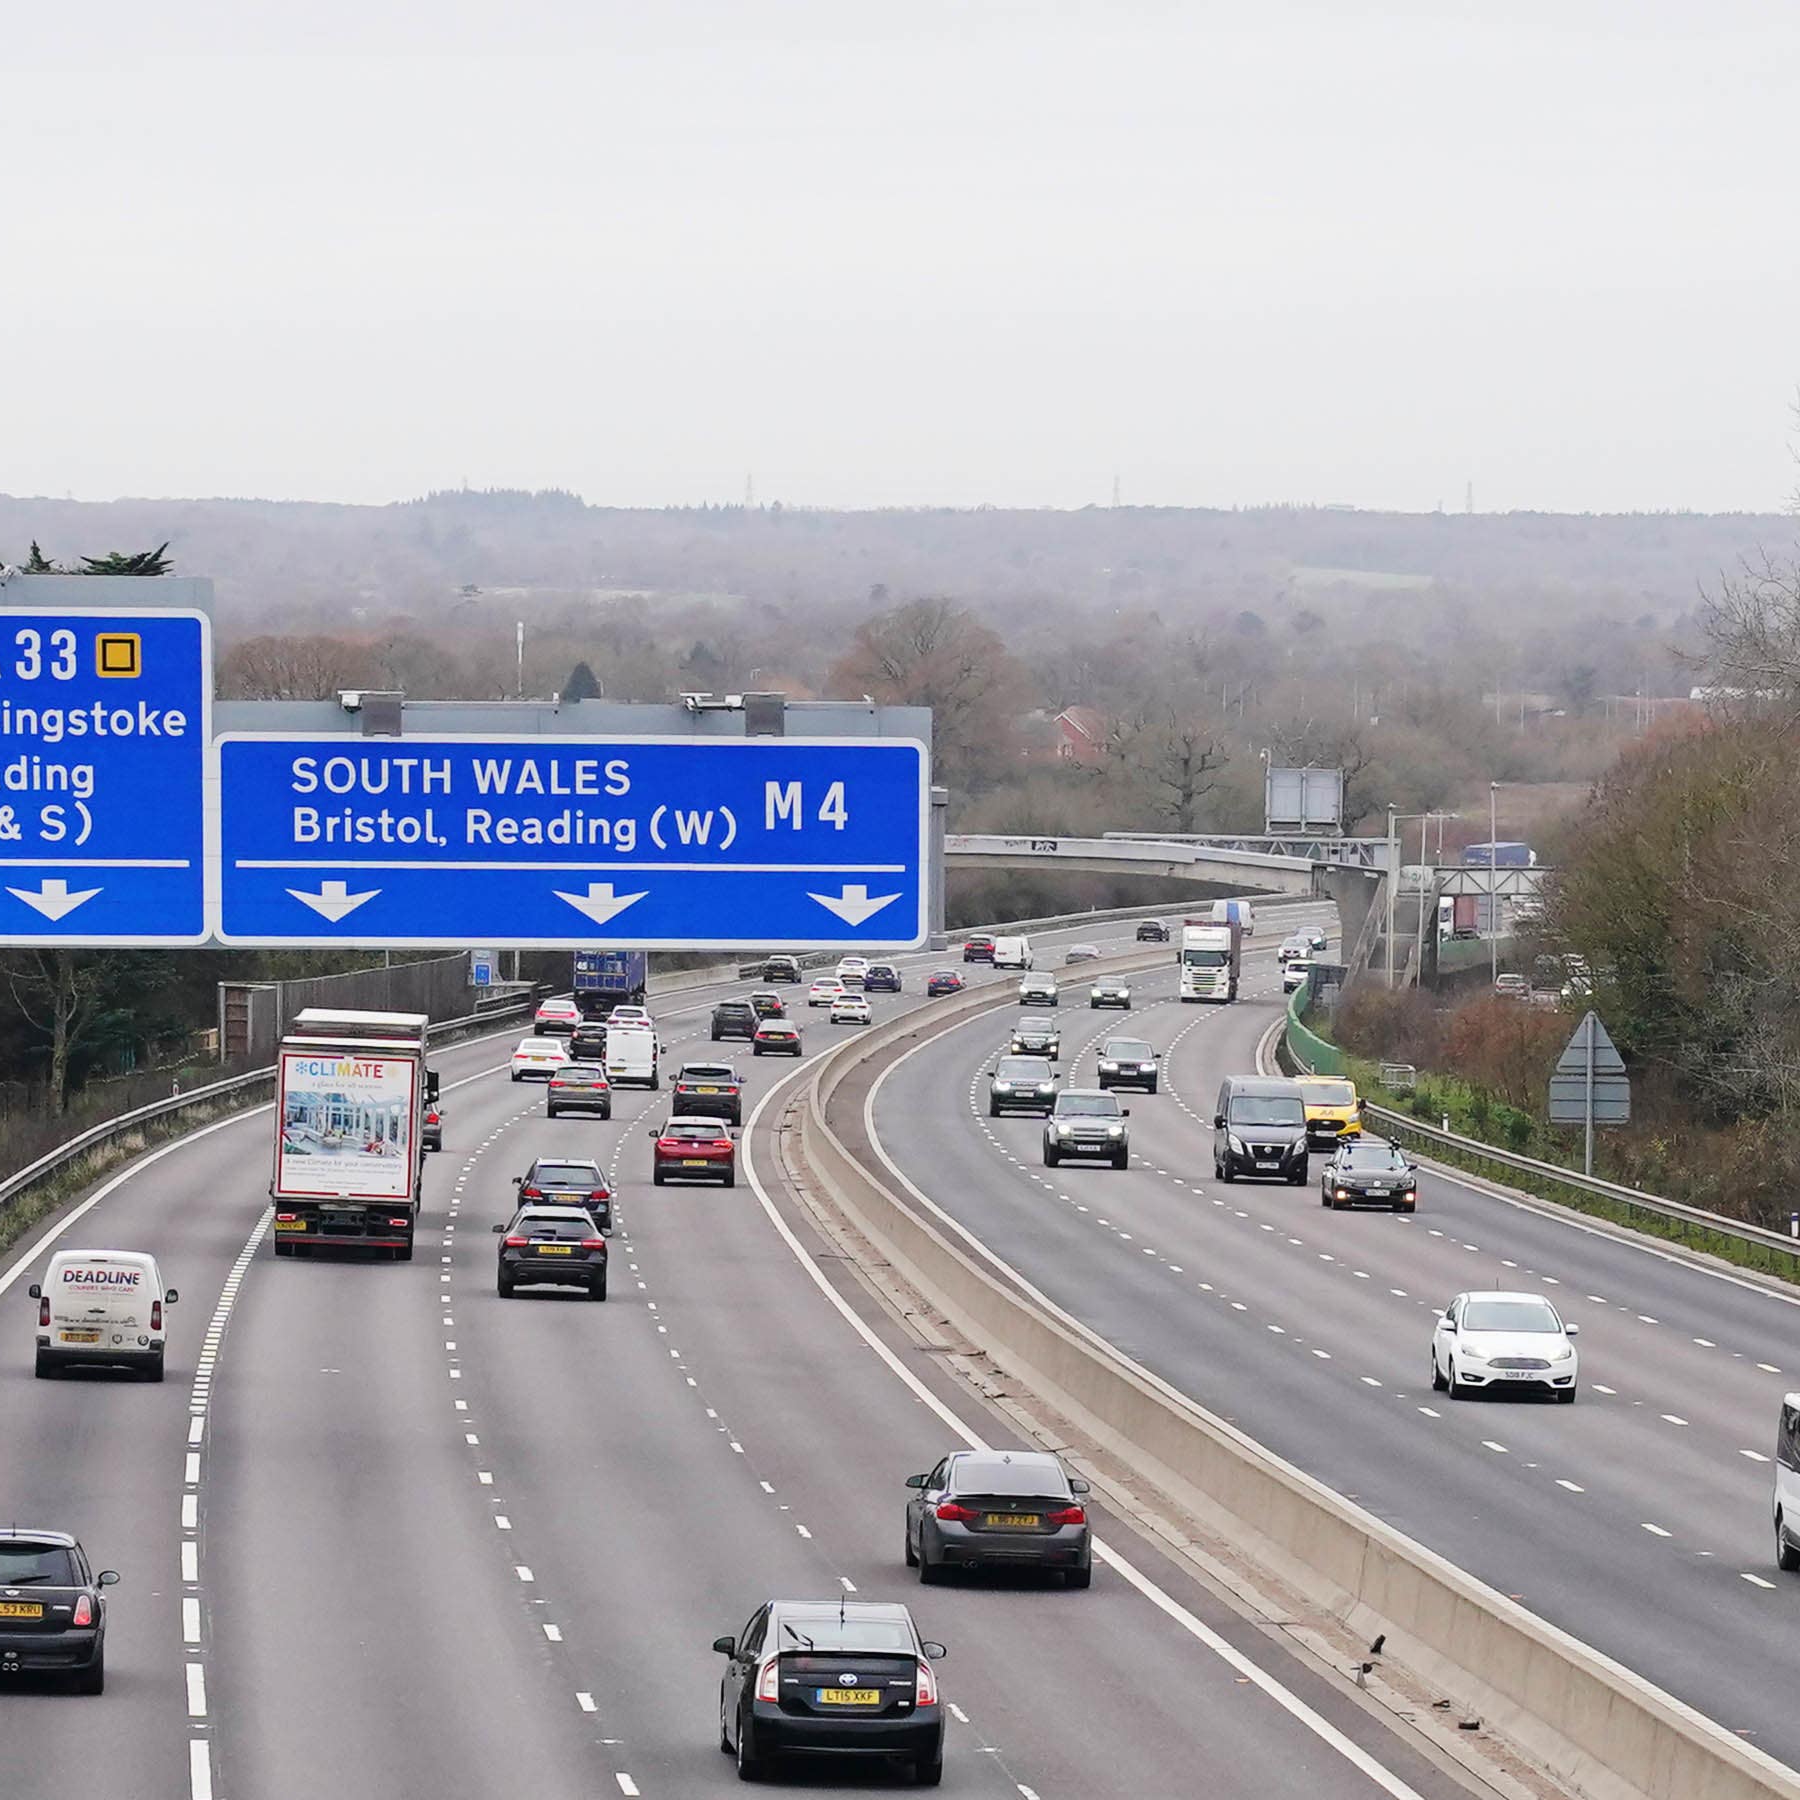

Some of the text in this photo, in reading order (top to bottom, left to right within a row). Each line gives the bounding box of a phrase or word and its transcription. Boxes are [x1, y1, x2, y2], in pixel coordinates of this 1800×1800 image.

[291, 756, 631, 796] SOUTH WALES
[293, 805, 737, 852] Bristol, Reading (W)
[309, 1062, 383, 1078] CLIMATE
[63, 1270, 140, 1285] DEADLINE
[826, 1690, 850, 1701] LT15
